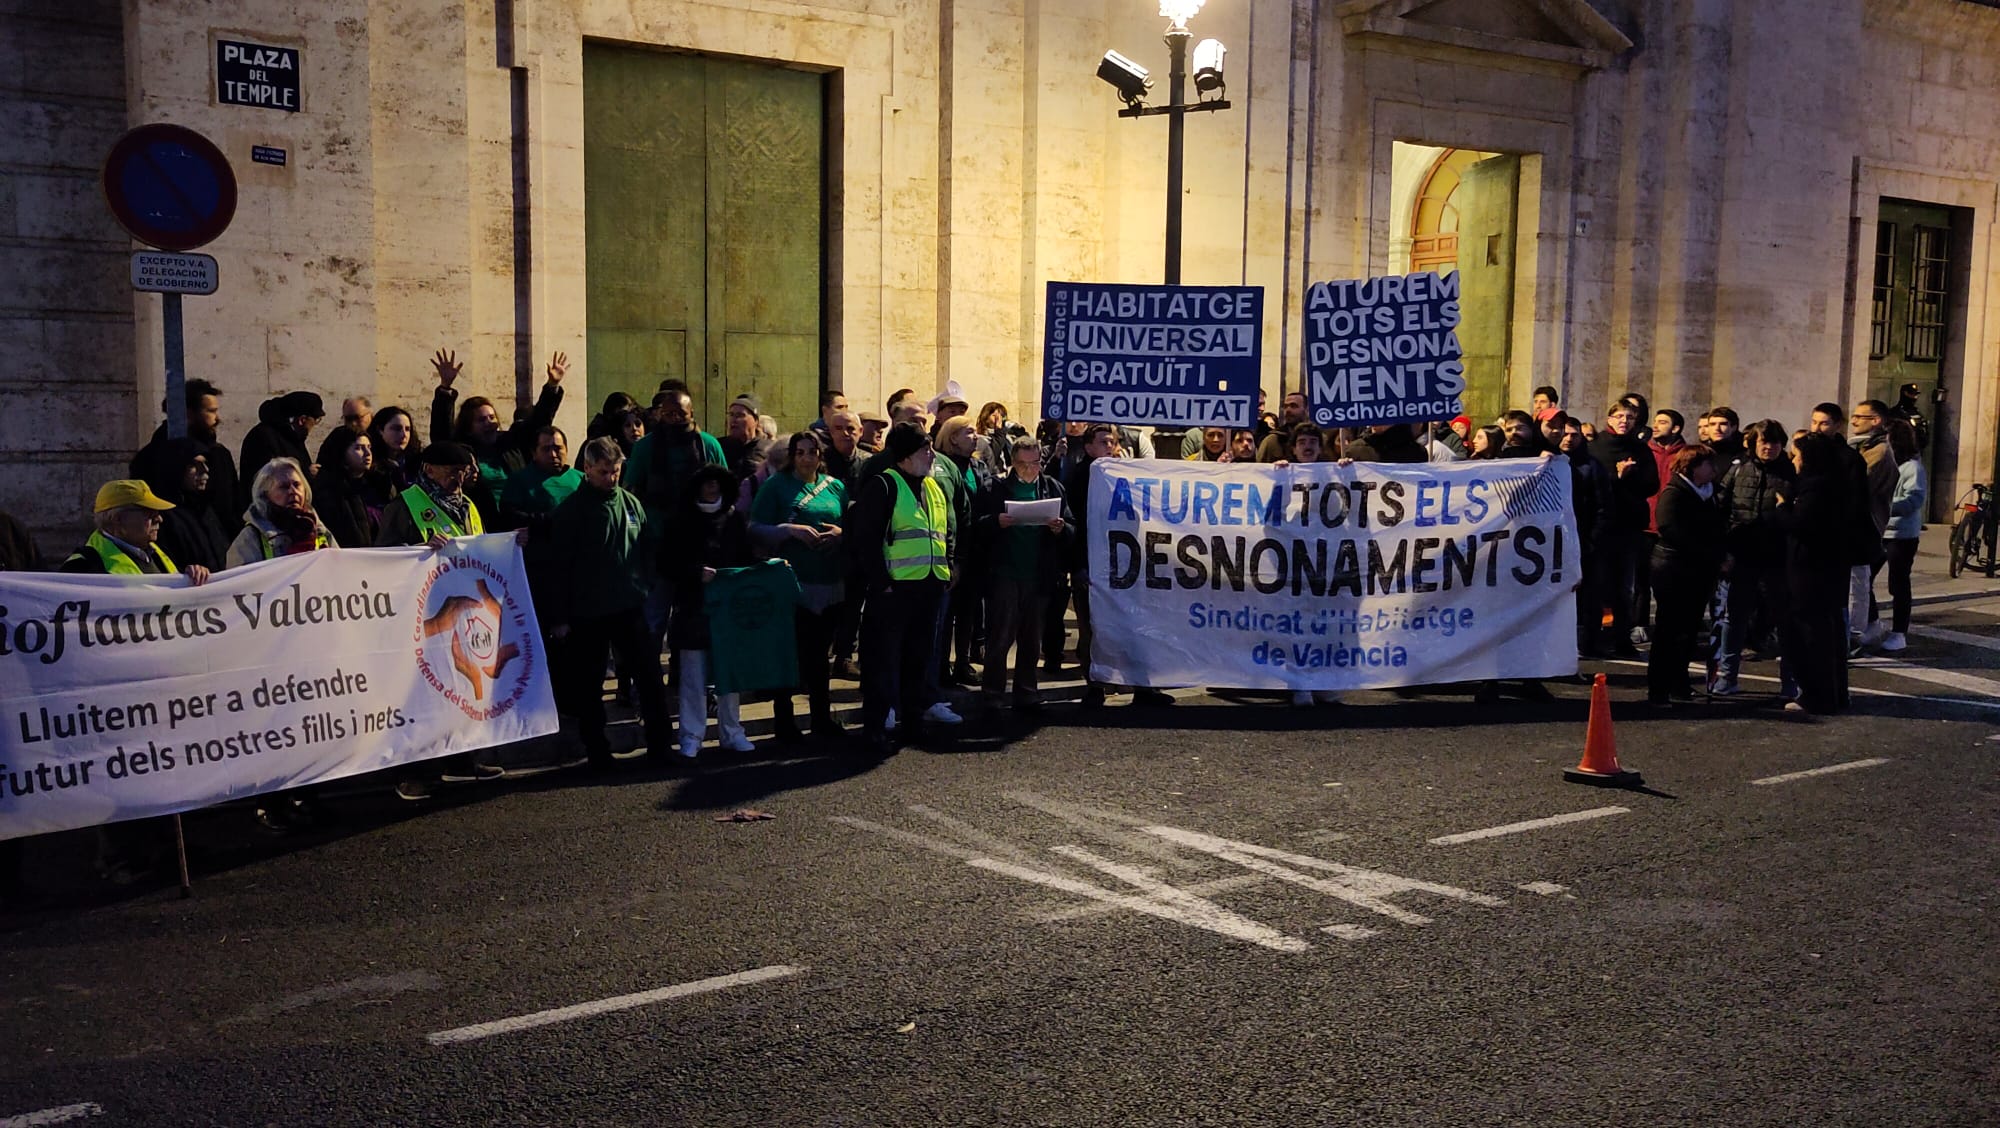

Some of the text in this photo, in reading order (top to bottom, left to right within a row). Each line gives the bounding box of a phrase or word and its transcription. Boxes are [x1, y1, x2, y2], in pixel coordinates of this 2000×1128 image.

[225, 45, 292, 70] PLAZA
[249, 69, 269, 82] DEL
[225, 80, 294, 107] TEMPLE
[140, 256, 186, 267] EXCEPTO
[142, 267, 206, 278] DELEGACION
[139, 277, 209, 289] DE GOBIERNO
[1309, 270, 1460, 310] ATUREM
[1072, 290, 1254, 319] HABITATGE
[1309, 301, 1461, 338] TOTS ELS
[1049, 290, 1067, 419] @sdhvalencia
[1074, 325, 1249, 353] UNIVERSAL
[1310, 331, 1463, 367] DESNONA
[1067, 357, 1206, 387] GRATUÏT I
[1312, 360, 1466, 405] MENTS
[1071, 394, 1247, 422] DE QUALITAT
[1315, 397, 1464, 425] @sdhvalencia
[1108, 477, 1489, 528] ATUREM TOTS ELS
[1108, 524, 1563, 598] DESNONAMENTS!
[233, 580, 396, 630] Valencia
[413, 562, 450, 642] Coordinadora
[1188, 602, 1303, 635] Sindicat
[1251, 641, 1408, 668] de València
[415, 648, 445, 692] Defensa
[444, 689, 461, 706] del
[20, 668, 368, 743] Lluitem per a defendre
[106, 741, 176, 779] dels
[185, 725, 296, 765] nostres
[302, 711, 346, 745] fills
[350, 709, 358, 736] i
[363, 706, 415, 734] nets.
